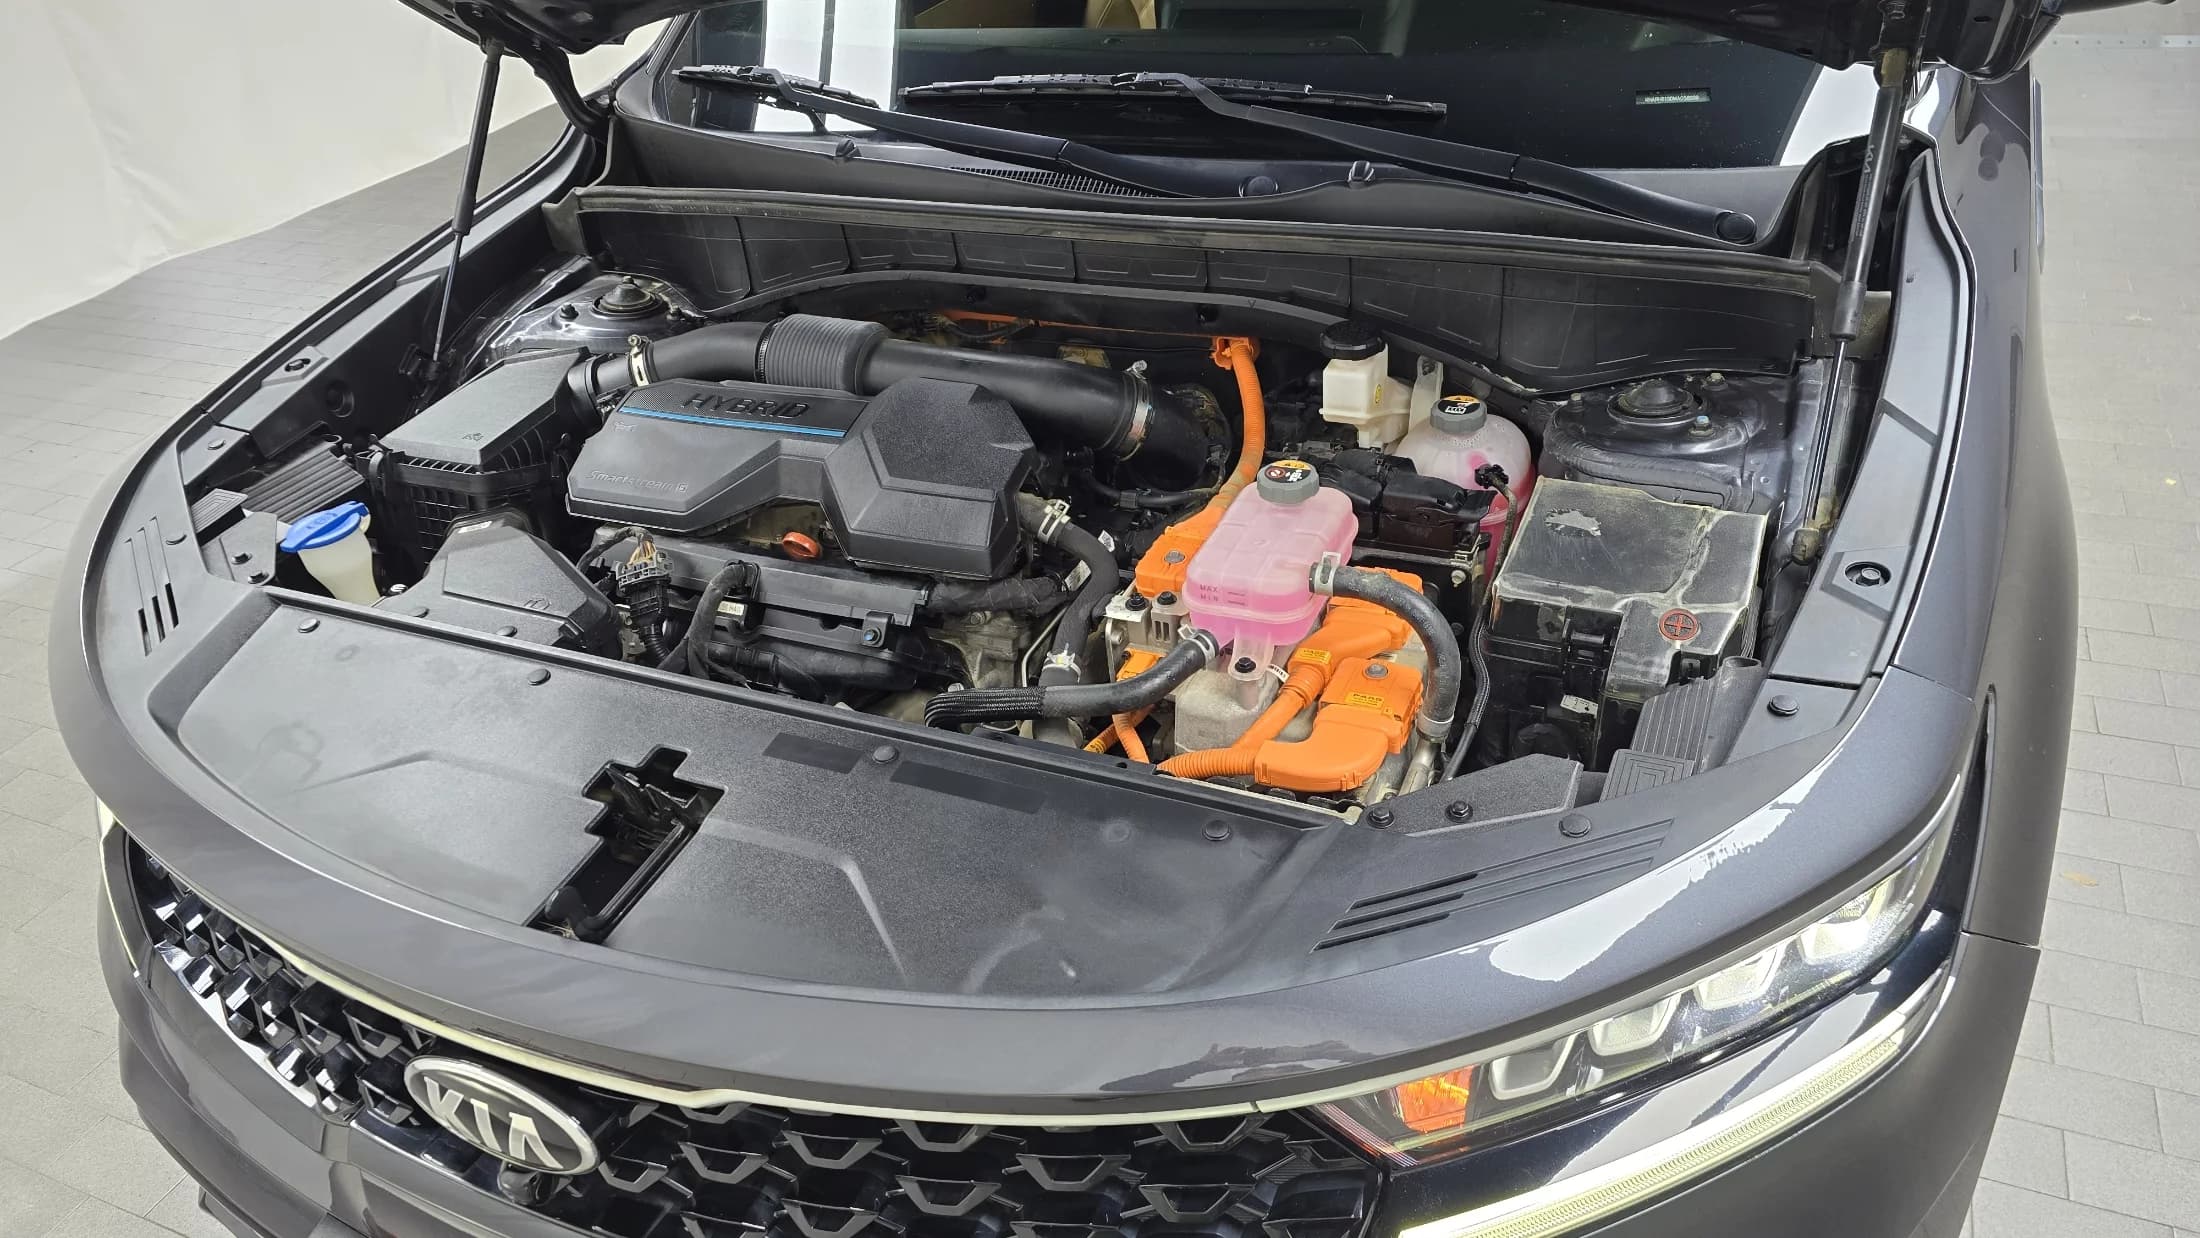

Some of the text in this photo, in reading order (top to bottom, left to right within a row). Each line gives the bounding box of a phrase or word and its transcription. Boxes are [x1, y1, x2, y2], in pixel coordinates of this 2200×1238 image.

[681, 393, 811, 419] HYBRID
[586, 470, 674, 491] Smartstream
[1200, 584, 1218, 593] MAX
[1200, 593, 1219, 602] MIN
[423, 1076, 564, 1169] KIA
